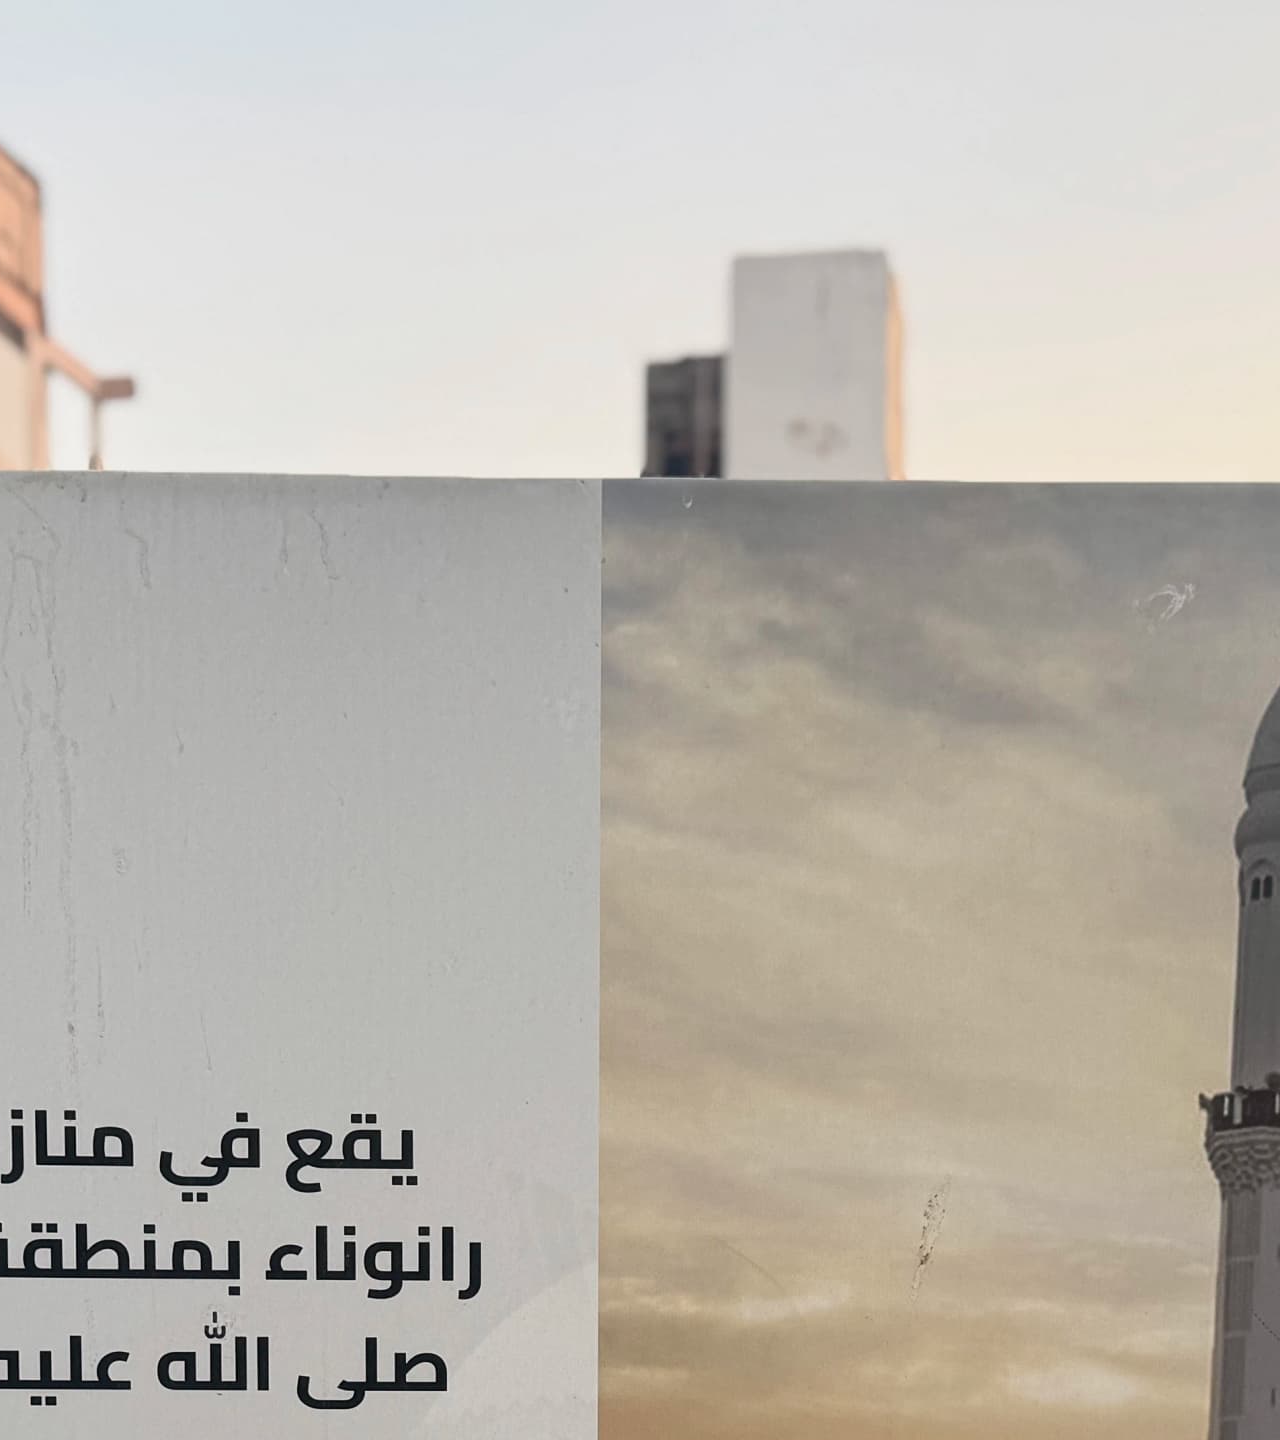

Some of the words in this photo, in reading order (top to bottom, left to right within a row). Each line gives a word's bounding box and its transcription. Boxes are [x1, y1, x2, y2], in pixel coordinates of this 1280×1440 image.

[159, 1112, 261, 1203] في
[285, 1113, 418, 1194] يقع
[265, 1225, 482, 1300] رانوناء
[296, 1336, 448, 1410] صلى
